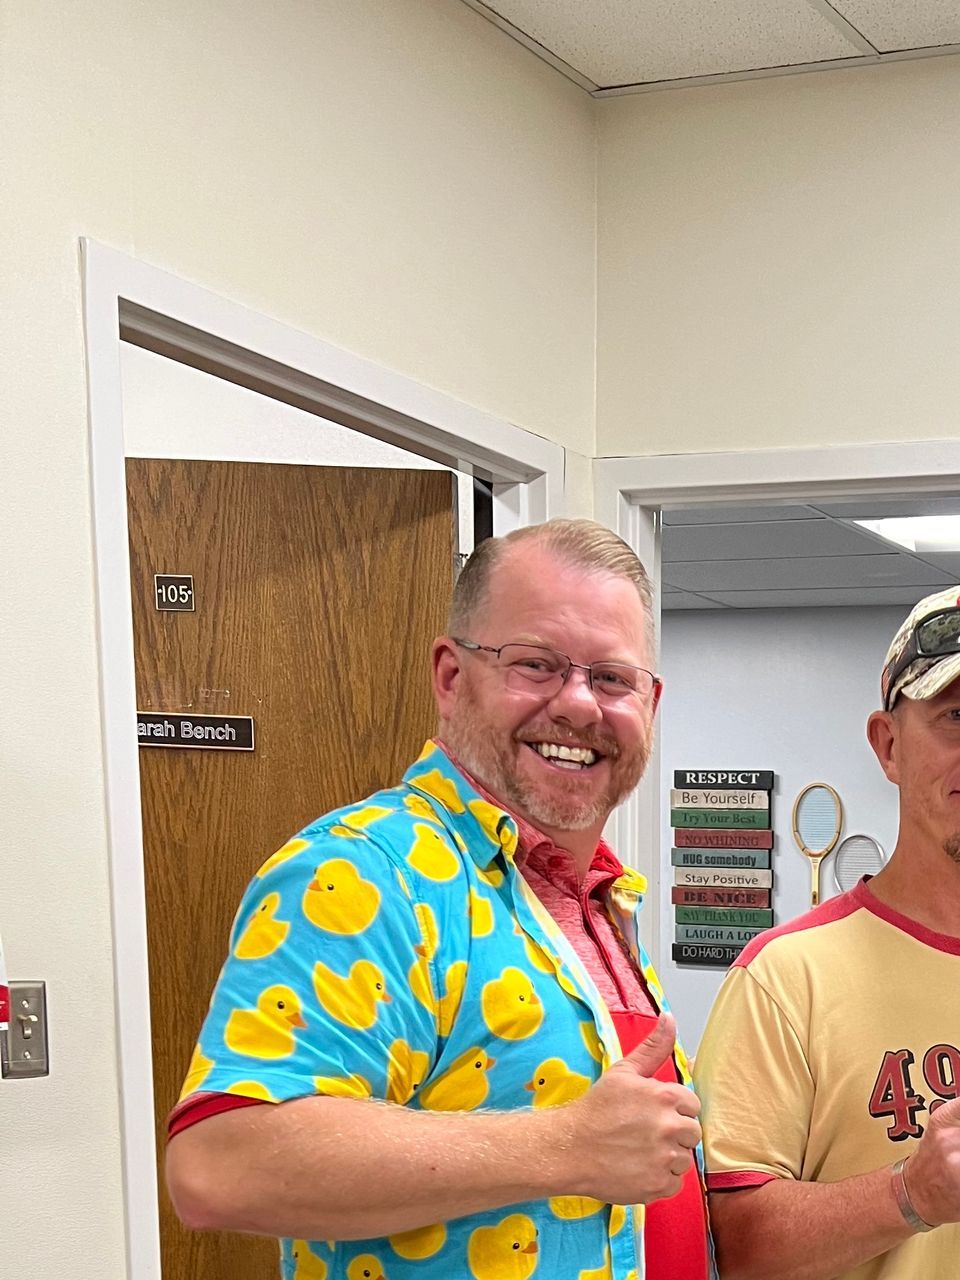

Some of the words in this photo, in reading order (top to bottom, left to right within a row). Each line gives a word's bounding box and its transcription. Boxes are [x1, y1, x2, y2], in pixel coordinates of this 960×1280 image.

[161, 585, 189, 603] 105
[137, 720, 175, 737] arah
[181, 721, 236, 740] Bench
[686, 772, 760, 785] RESPECT
[682, 792, 698, 804] Be
[703, 792, 757, 805] Yourself
[682, 812, 699, 825] Try
[703, 813, 730, 824] Your
[733, 814, 757, 824] Best
[685, 835, 701, 846] NO
[704, 835, 759, 847] WHINING
[682, 853, 702, 865] HUG
[705, 854, 757, 867] somebody
[685, 873, 710, 885] Stay
[713, 874, 759, 885] Positive
[683, 891, 707, 902] BE
[714, 892, 757, 904] NICE
[683, 910, 701, 921] SAY
[703, 910, 736, 922] THANK
[738, 911, 760, 923] YOU
[685, 928, 724, 940] LAUGH
[726, 931, 734, 940] A
[682, 946, 697, 957] DO
[699, 946, 723, 958] HARD
